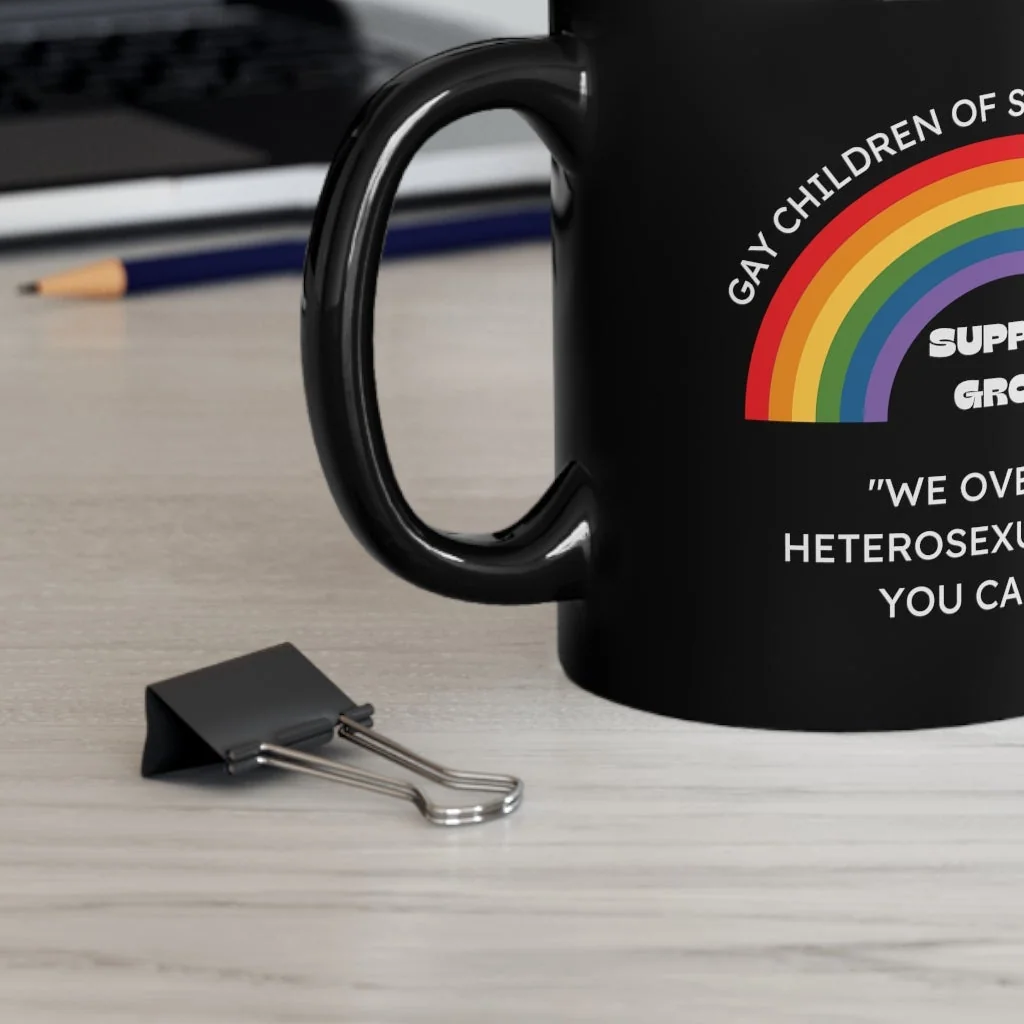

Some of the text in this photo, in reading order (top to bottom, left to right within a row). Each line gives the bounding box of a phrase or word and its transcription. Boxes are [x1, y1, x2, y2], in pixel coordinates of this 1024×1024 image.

[729, 231, 777, 304] GAY
[774, 109, 942, 233] CHILDREN
[952, 92, 995, 127] OF
[879, 583, 961, 618] YOU
